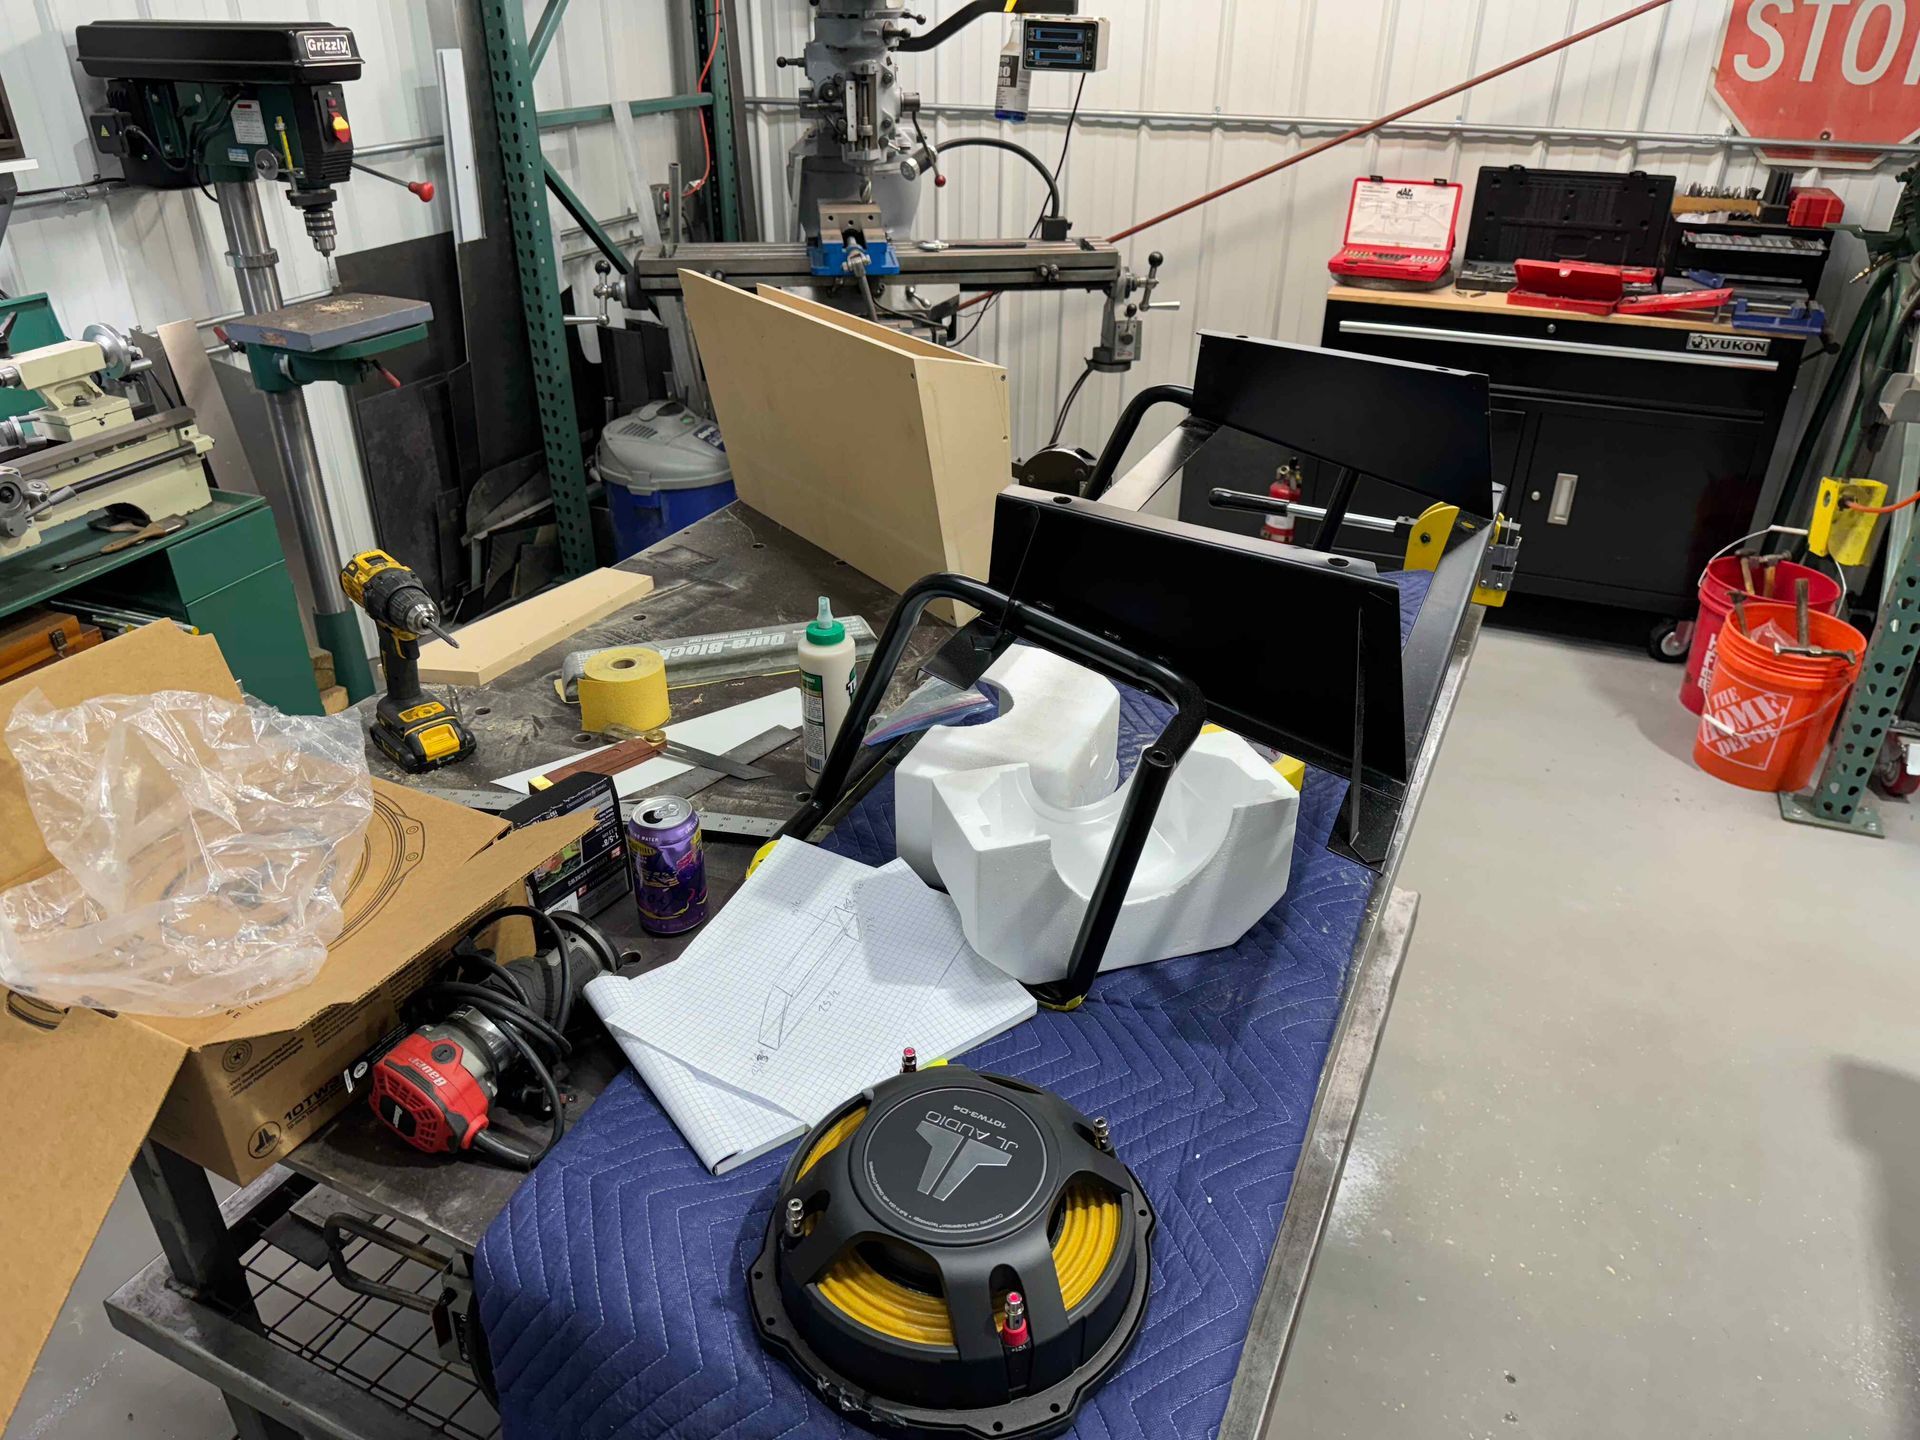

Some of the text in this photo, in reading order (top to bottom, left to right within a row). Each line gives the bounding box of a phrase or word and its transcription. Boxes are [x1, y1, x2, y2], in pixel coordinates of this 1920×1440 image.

[307, 38, 347, 54] Grizzly
[1733, 0, 1920, 86] STO
[1709, 339, 1766, 352] YUKON
[1711, 686, 1741, 709] THE
[1702, 691, 1787, 744] HOME
[1716, 722, 1779, 756] DEPOT
[925, 1110, 1019, 1151] JL AUDIO
